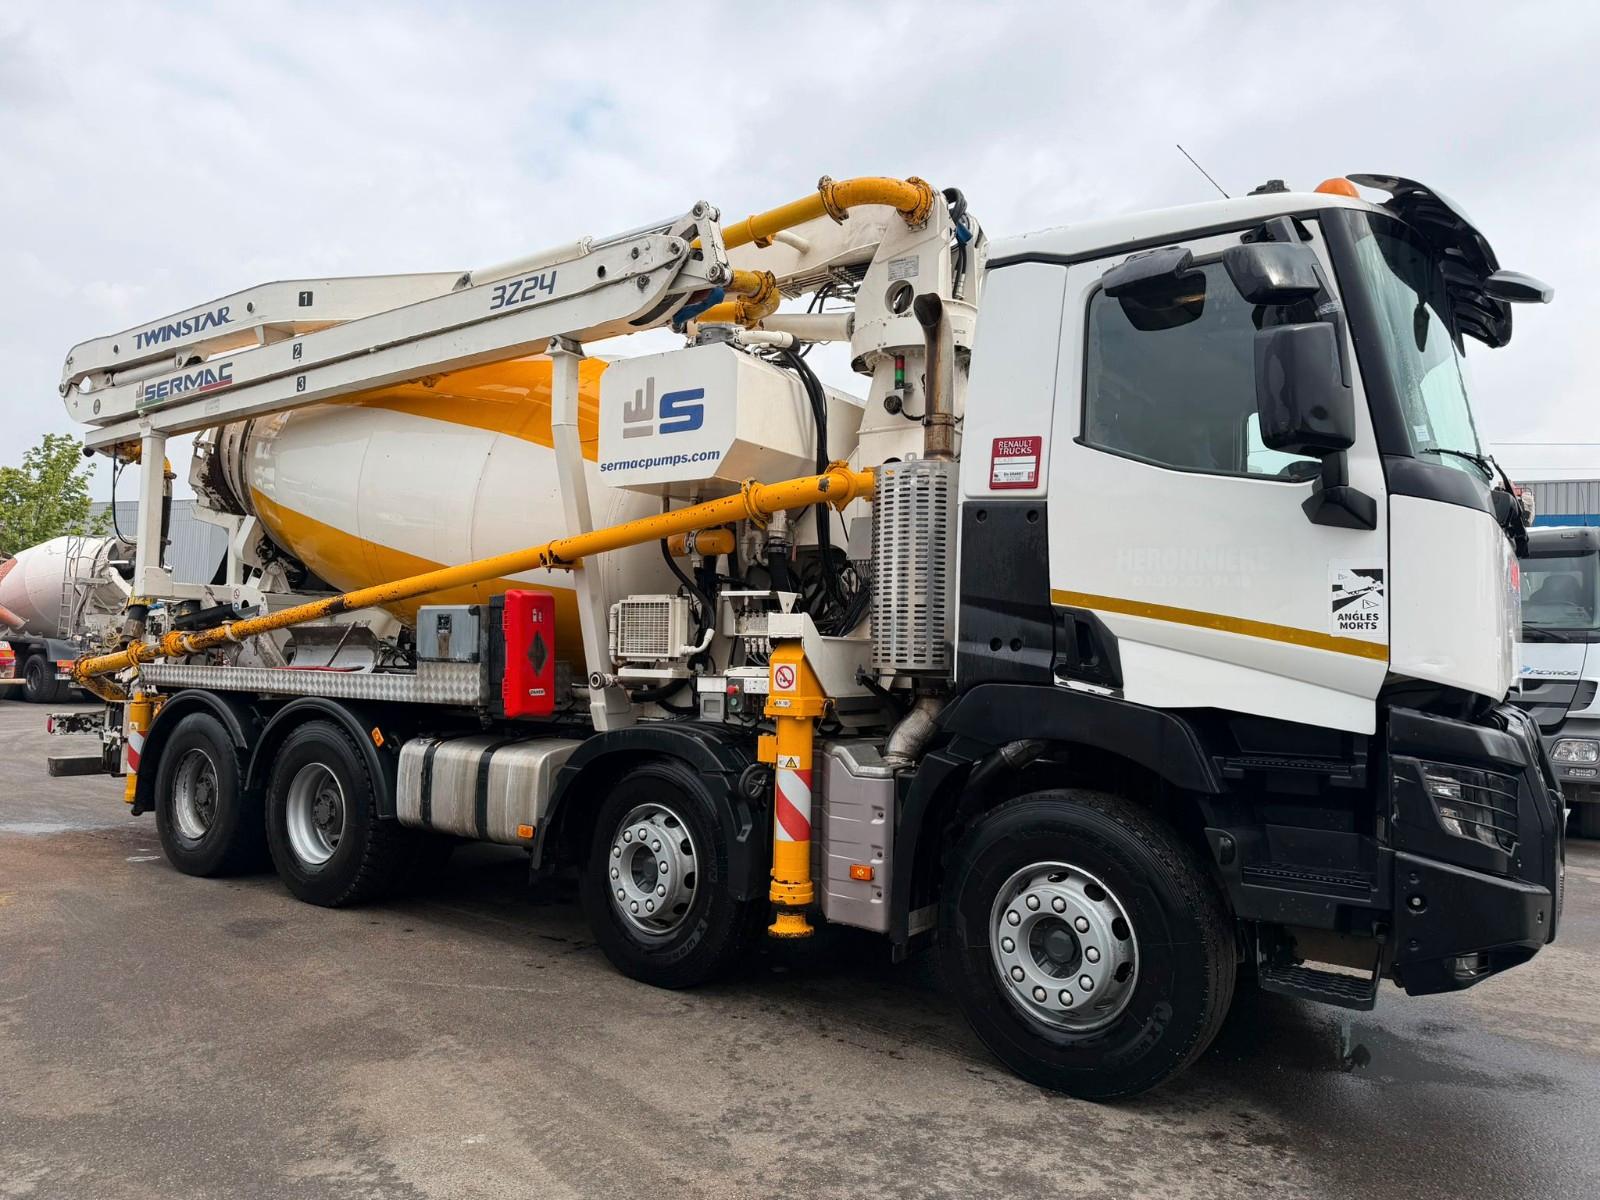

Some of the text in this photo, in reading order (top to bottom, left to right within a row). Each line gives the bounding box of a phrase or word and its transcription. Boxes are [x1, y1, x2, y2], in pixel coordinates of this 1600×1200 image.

[133, 306, 235, 350] TWINSTAR
[145, 362, 233, 401] SERMAC
[998, 440, 1033, 448] RENAULT
[999, 447, 1032, 455] TRUCKS
[600, 449, 720, 472] sermacpumps.com
[1337, 613, 1379, 621] ANGLES
[1340, 622, 1377, 630] MORTS
